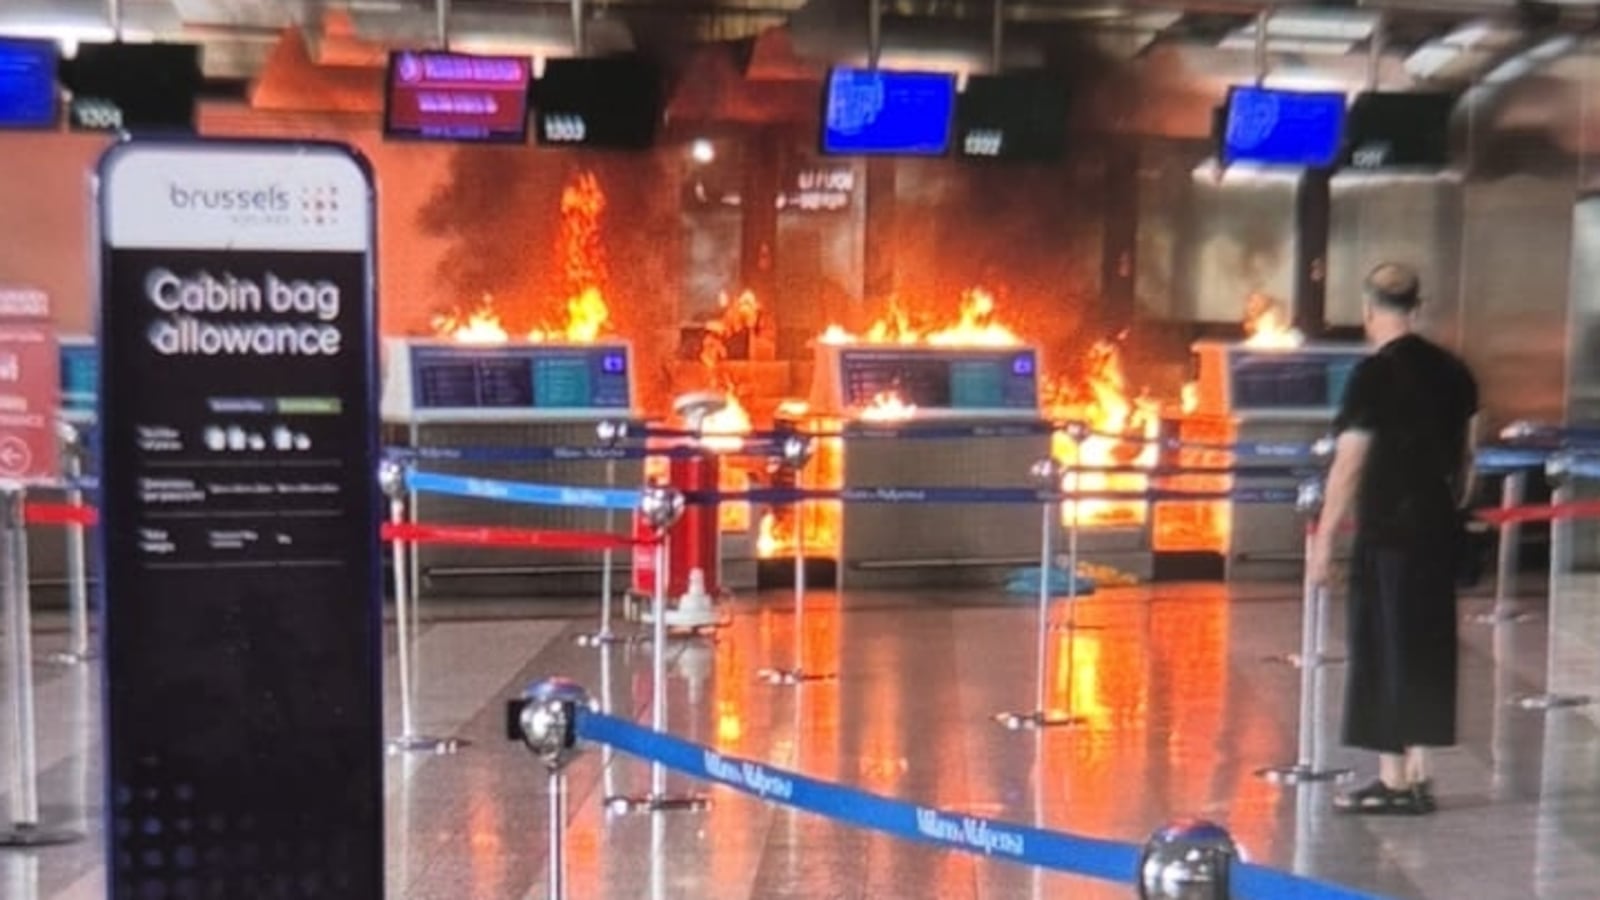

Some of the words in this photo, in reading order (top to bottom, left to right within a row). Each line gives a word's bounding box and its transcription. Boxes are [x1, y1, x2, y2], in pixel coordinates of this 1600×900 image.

[169, 183, 291, 209] brussels
[148, 268, 262, 312] Cabin
[266, 271, 340, 320] bag
[149, 315, 342, 355] allowance
